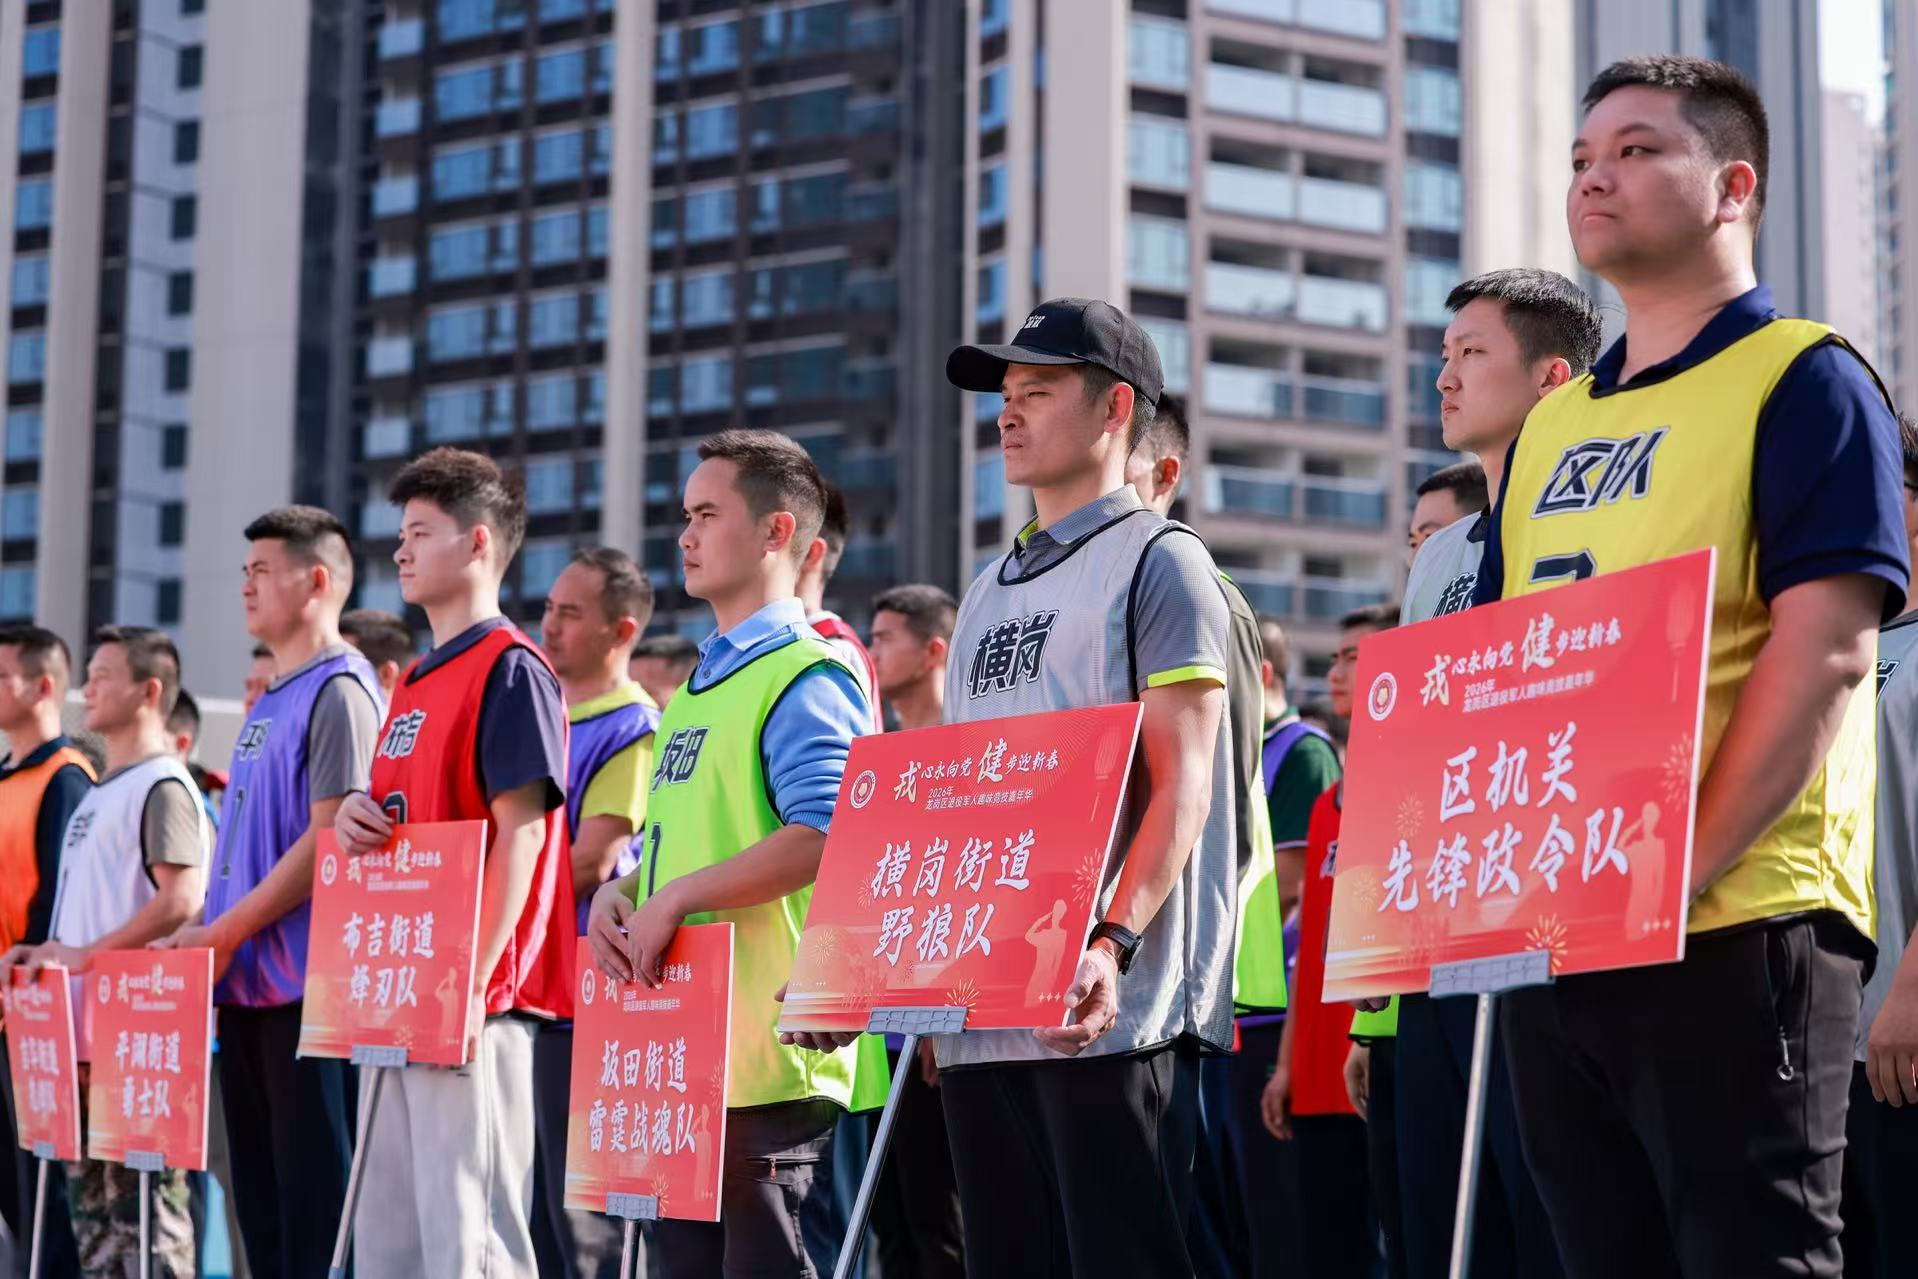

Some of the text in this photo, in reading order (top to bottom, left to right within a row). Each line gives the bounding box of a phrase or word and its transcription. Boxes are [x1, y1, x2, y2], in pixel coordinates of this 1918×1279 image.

[1529, 425, 1671, 519] 区队
[968, 609, 1059, 700] 横岗
[1520, 612, 1622, 672] 健步迎新春
[649, 724, 711, 794] 坂田
[893, 760, 973, 803] 戎心永向党
[976, 737, 1060, 784] 健步迎新春
[1439, 720, 1578, 824] 区机关
[927, 786, 954, 799] 2026年
[869, 828, 1036, 899] 横岗街道
[1377, 807, 1629, 913] 先锋政令队
[342, 911, 436, 959] 布吉街道
[872, 902, 996, 967] 野狼队
[601, 1036, 688, 1093] 坂田街道
[588, 1098, 696, 1156] 雷霆战魂队
